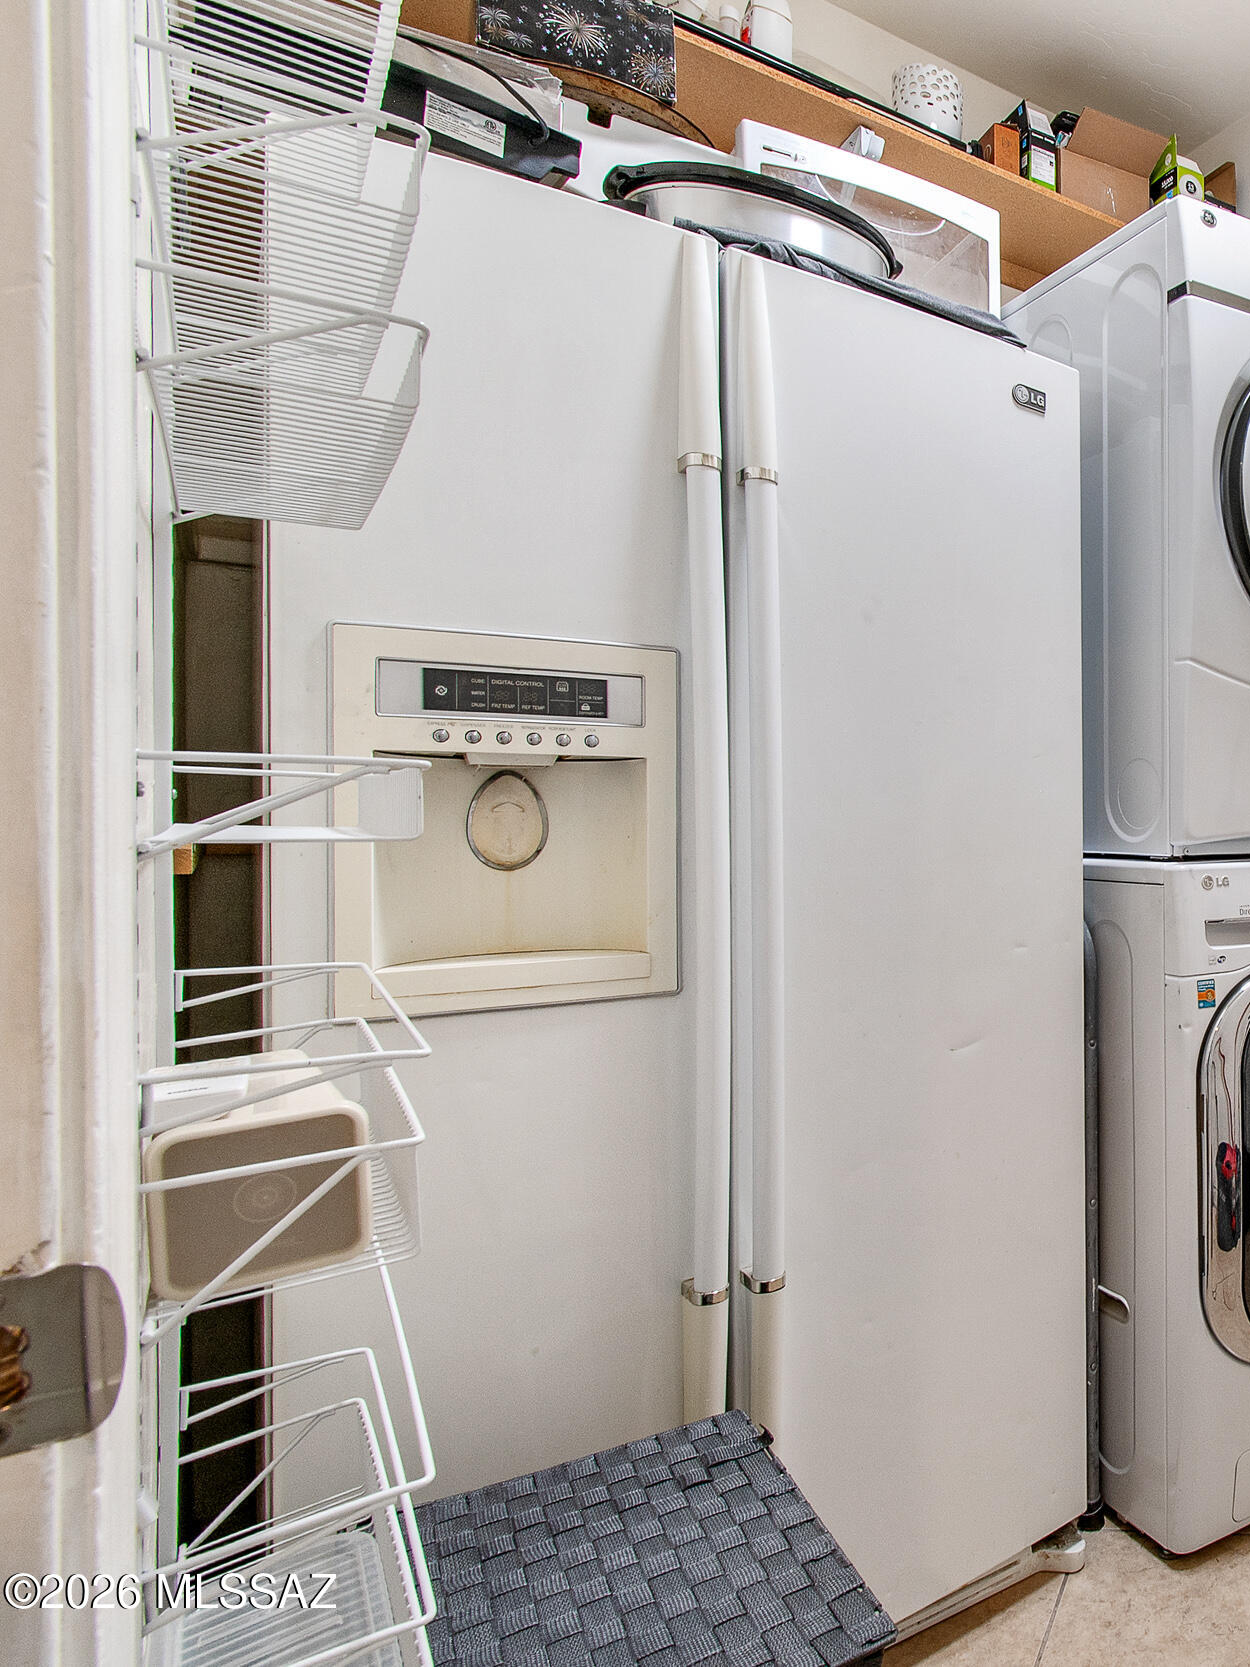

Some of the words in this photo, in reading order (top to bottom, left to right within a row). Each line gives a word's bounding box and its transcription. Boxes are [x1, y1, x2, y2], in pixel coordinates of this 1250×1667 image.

[1030, 392, 1045, 407] LG
[515, 680, 545, 688] CONTROL
[1215, 876, 1230, 888] LG
